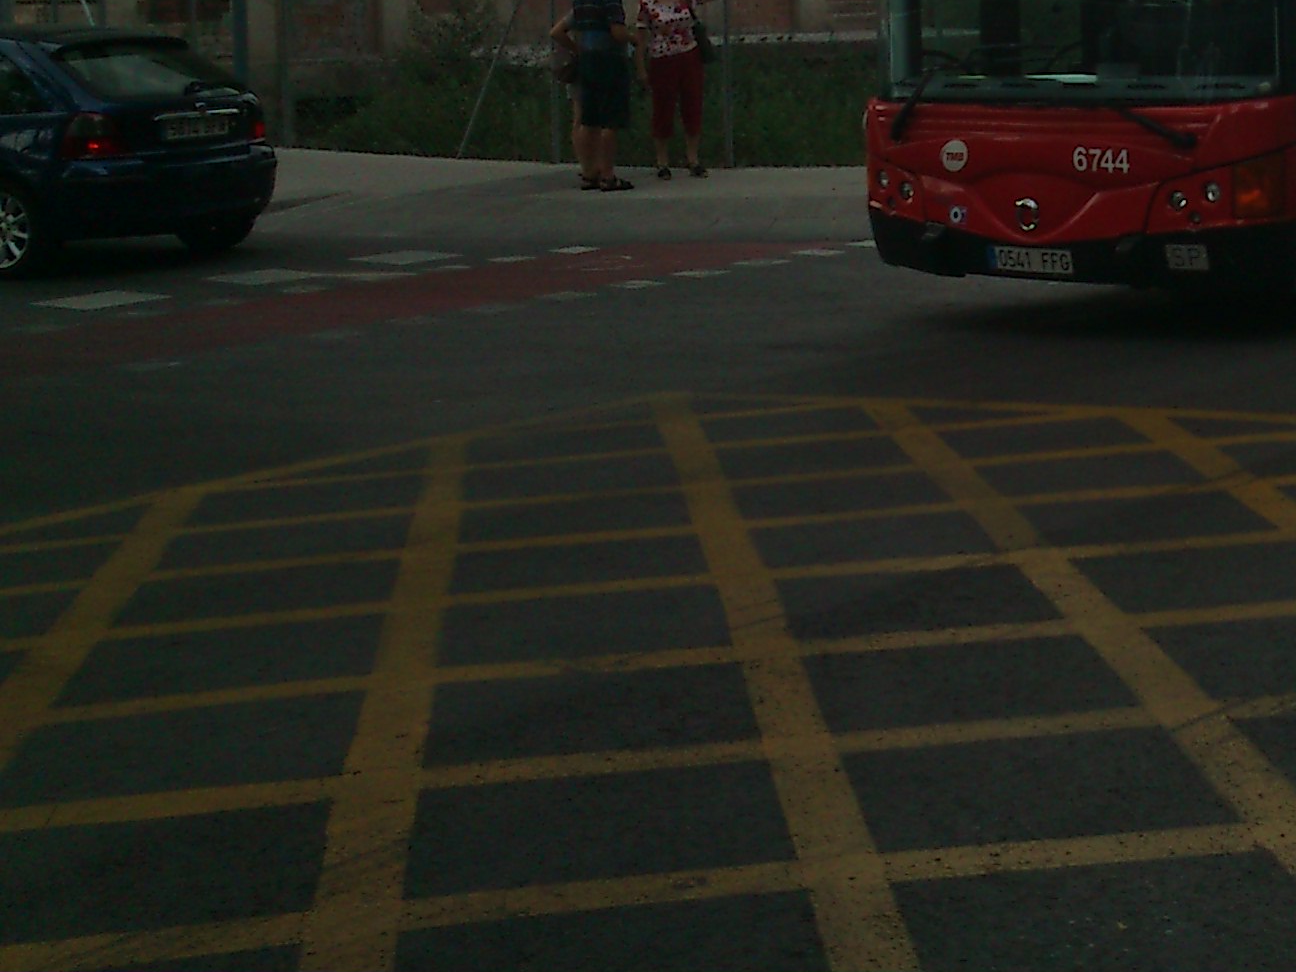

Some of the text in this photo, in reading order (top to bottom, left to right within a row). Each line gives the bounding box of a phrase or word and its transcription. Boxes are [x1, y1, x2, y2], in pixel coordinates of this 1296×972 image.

[1072, 145, 1130, 174] 6744
[998, 248, 1071, 271] 0541 FFG
